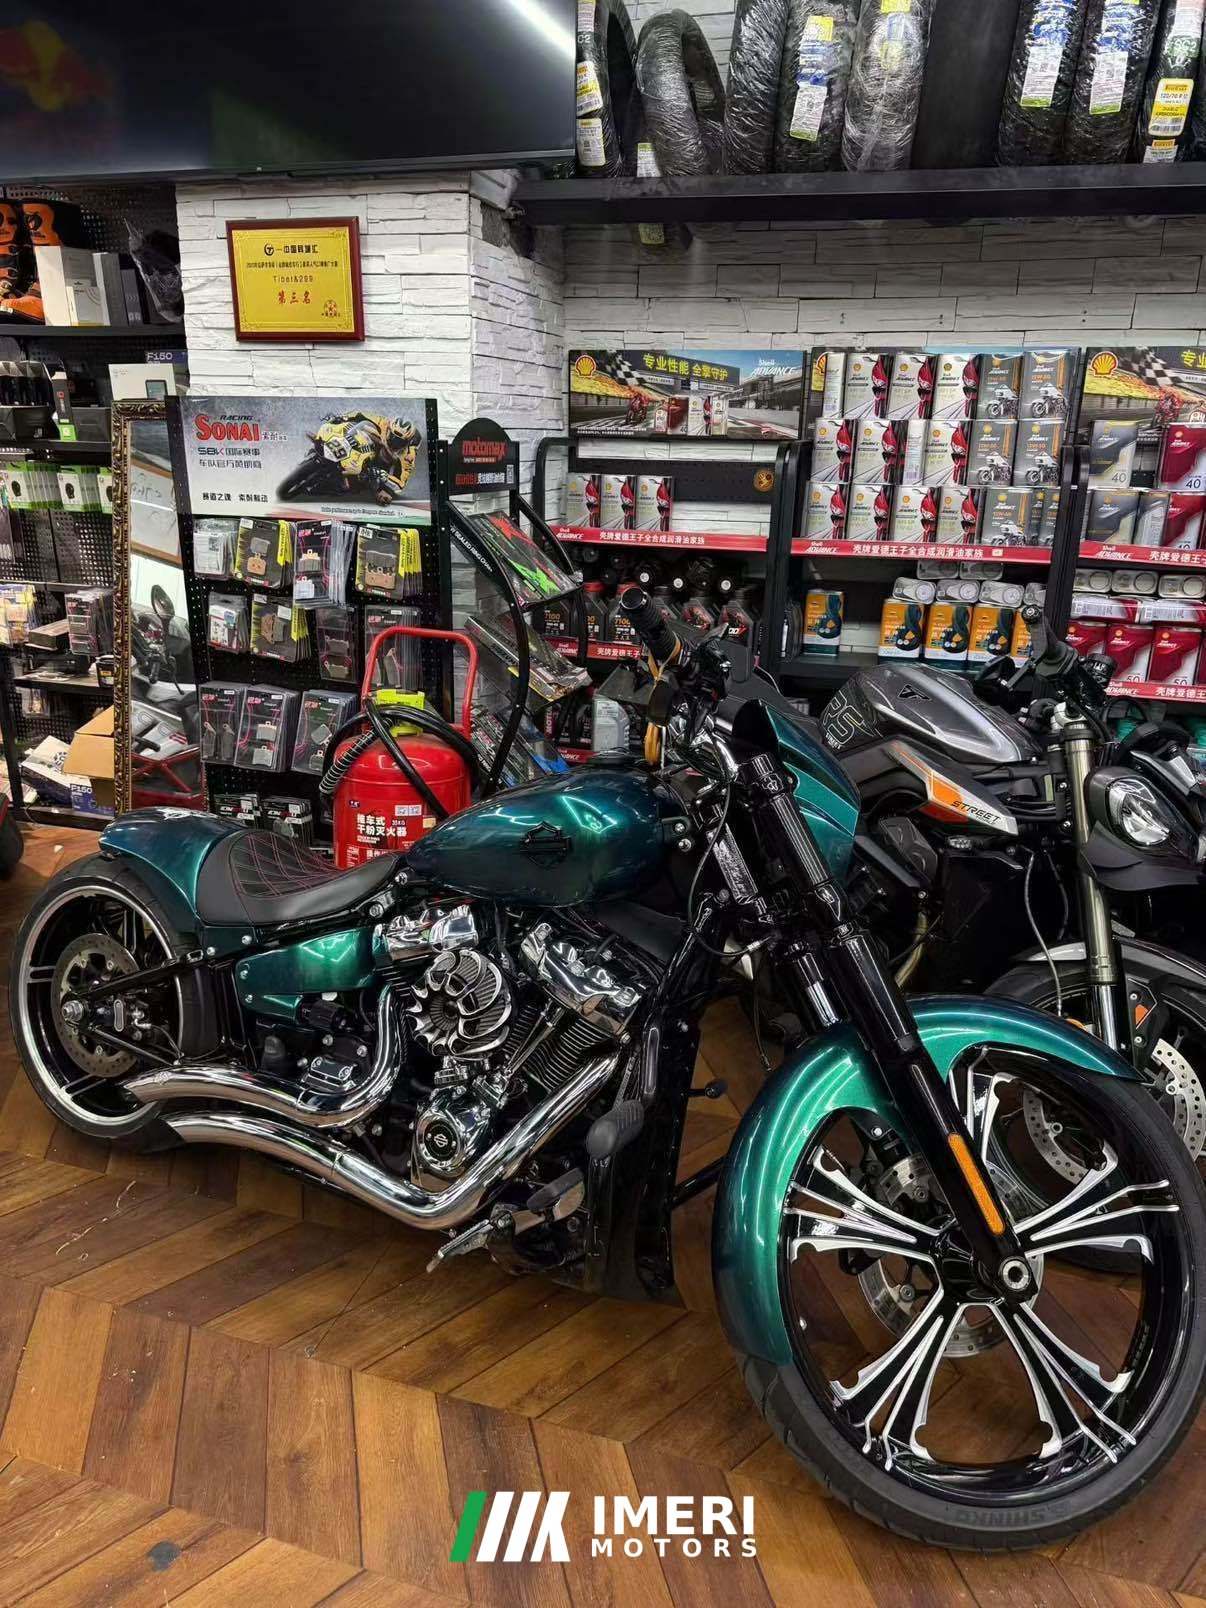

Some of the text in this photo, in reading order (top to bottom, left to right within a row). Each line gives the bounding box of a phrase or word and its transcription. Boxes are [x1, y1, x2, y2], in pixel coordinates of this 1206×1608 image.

[642, 353, 690, 376] 专业性能
[750, 366, 796, 377] ADVANCE
[195, 413, 260, 442] SONAI
[1112, 472, 1127, 483] 40
[1186, 478, 1201, 489] 40
[951, 801, 1001, 822] STREET
[357, 814, 386, 826] 推车式
[357, 824, 408, 837] 干粉灭火器
